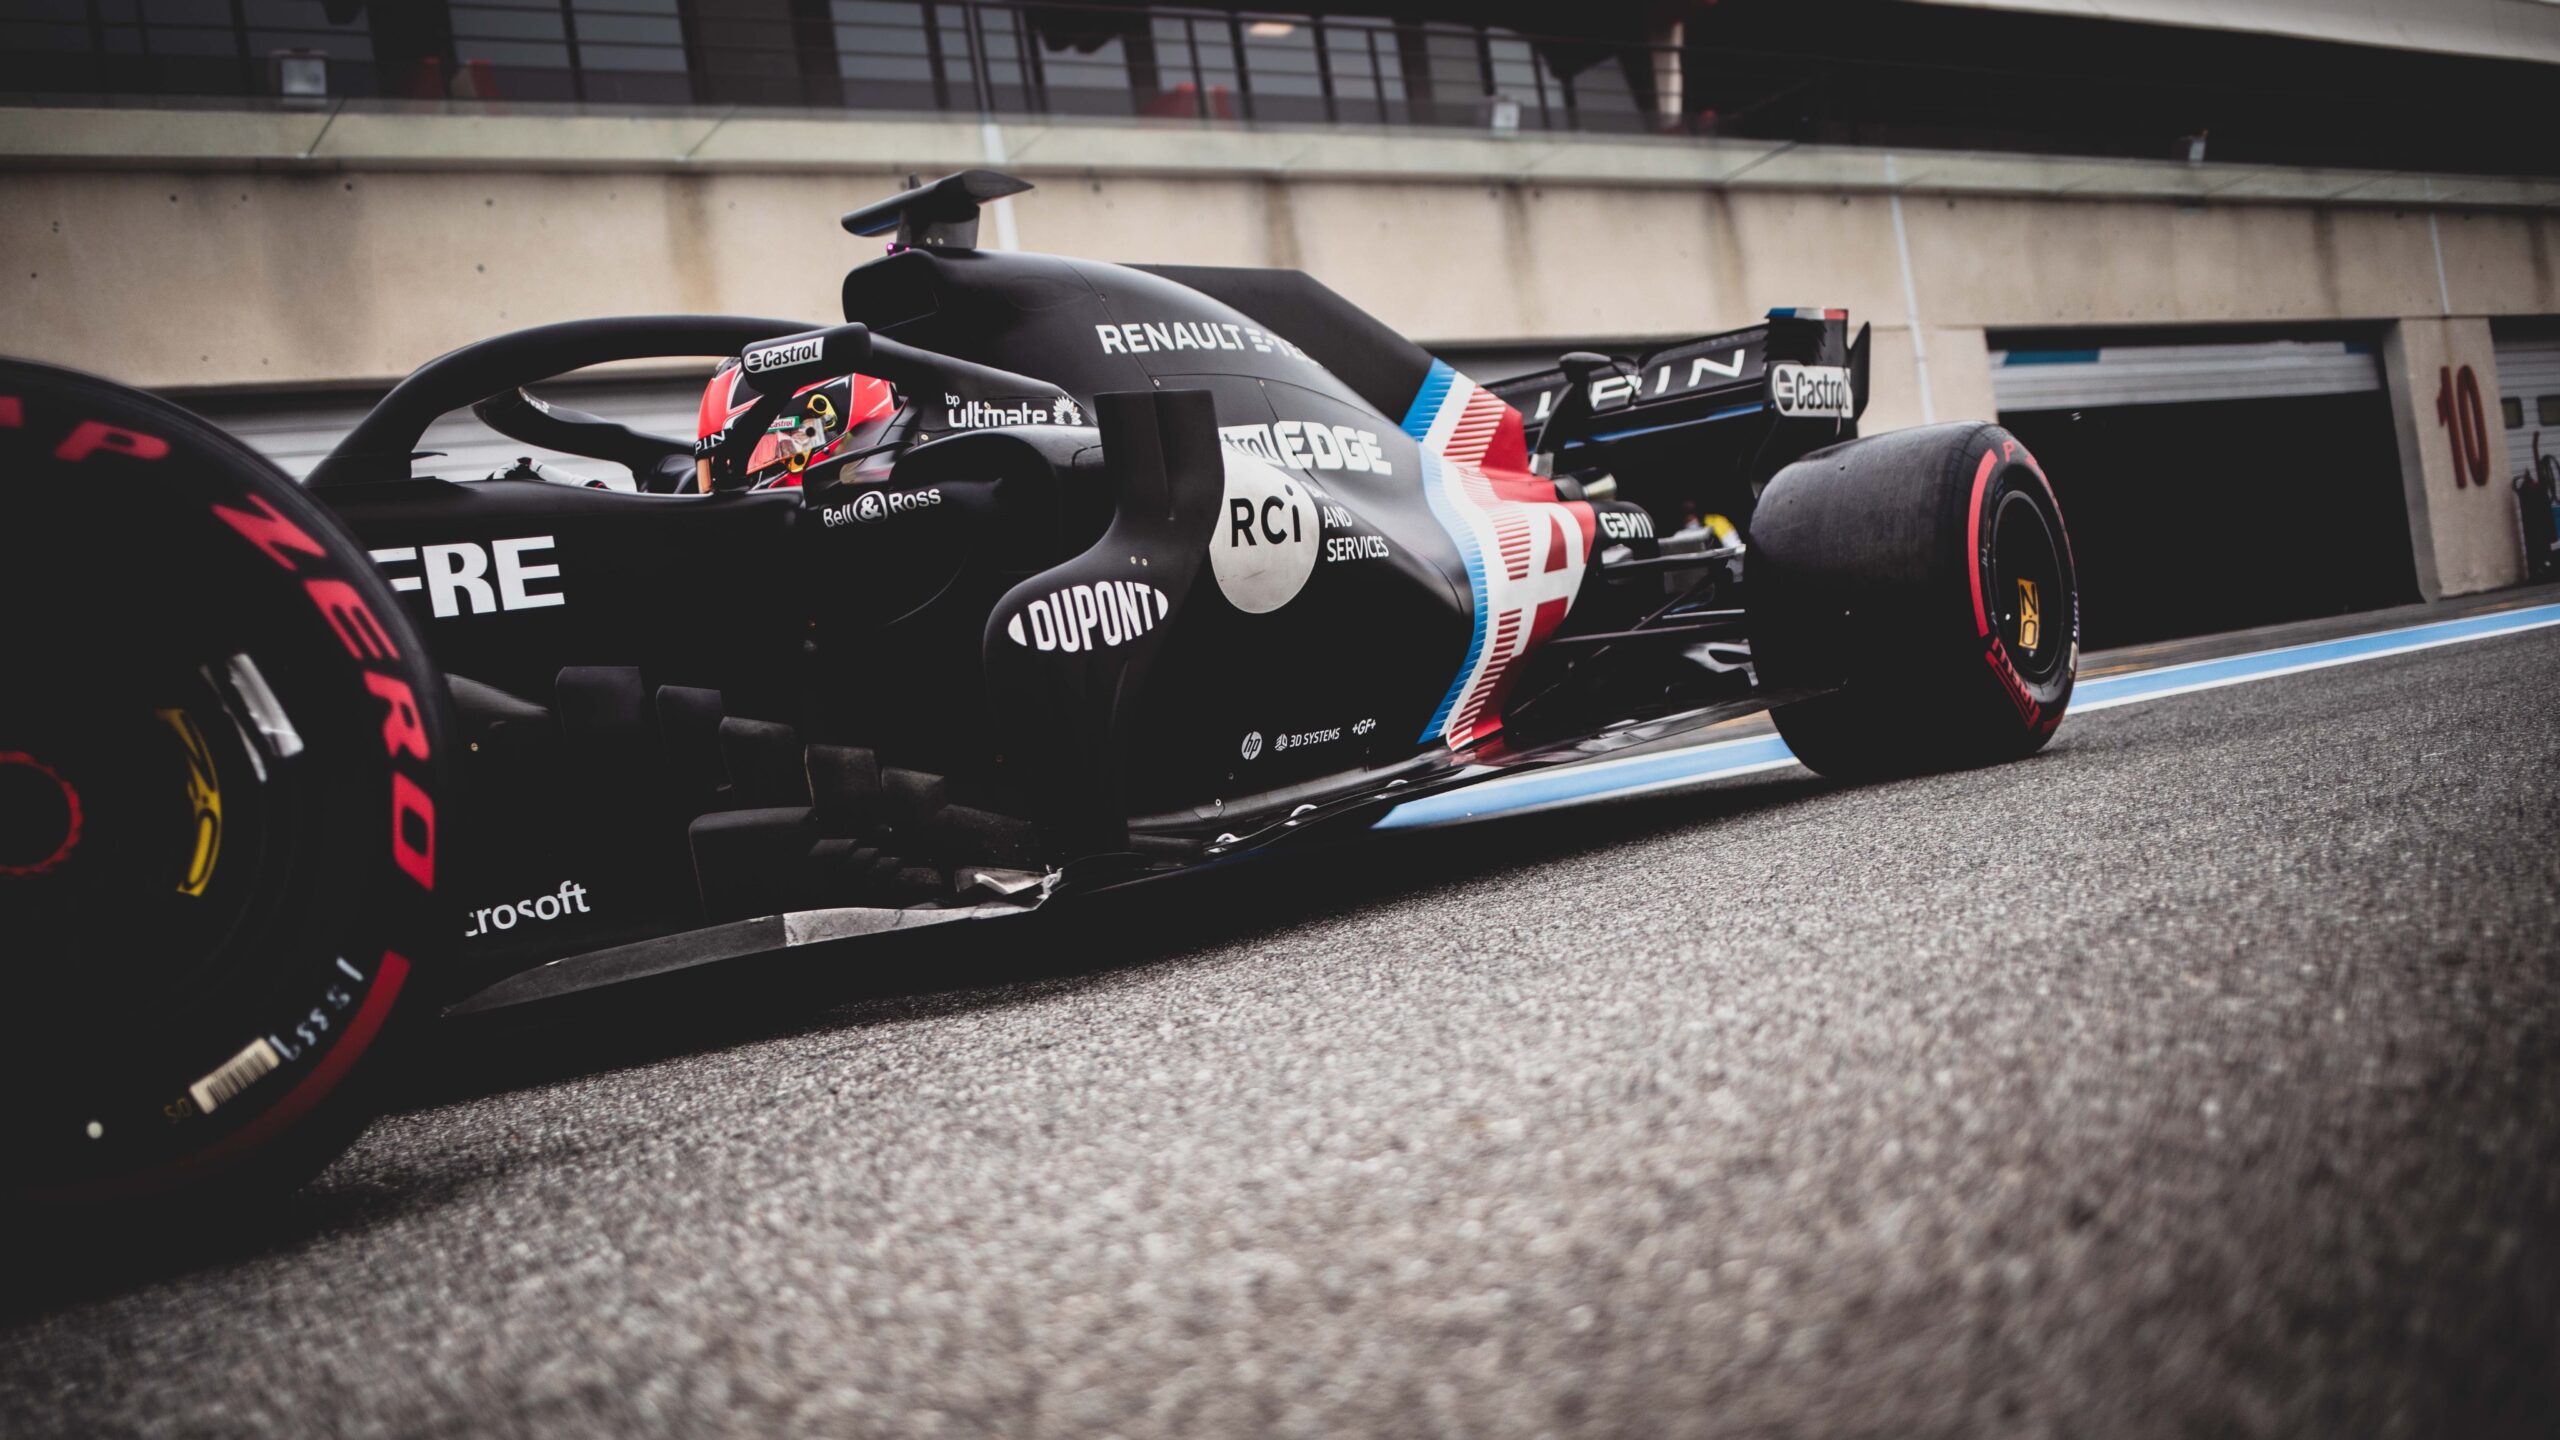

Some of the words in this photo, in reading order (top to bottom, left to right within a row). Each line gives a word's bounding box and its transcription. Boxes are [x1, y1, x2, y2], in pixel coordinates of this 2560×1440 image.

[1095, 322, 1245, 354] RENAULT
[763, 342, 818, 368] Castrol
[945, 392, 960, 406] bp
[1796, 371, 1851, 410] Castrol
[949, 401, 1047, 428] ultimate
[2437, 365, 2489, 489] 10
[1273, 421, 1392, 475] EDGE
[823, 505, 850, 527] Bell
[1323, 506, 1352, 528] AND
[1326, 536, 1389, 562] SERVICES
[1028, 581, 1153, 653] DUPONT
[54, 419, 172, 463] P
[211, 492, 437, 891] ZERO
[1241, 731, 1263, 760] hp
[1290, 734, 1302, 747] 3D
[1303, 728, 1341, 745] SYSTEMS
